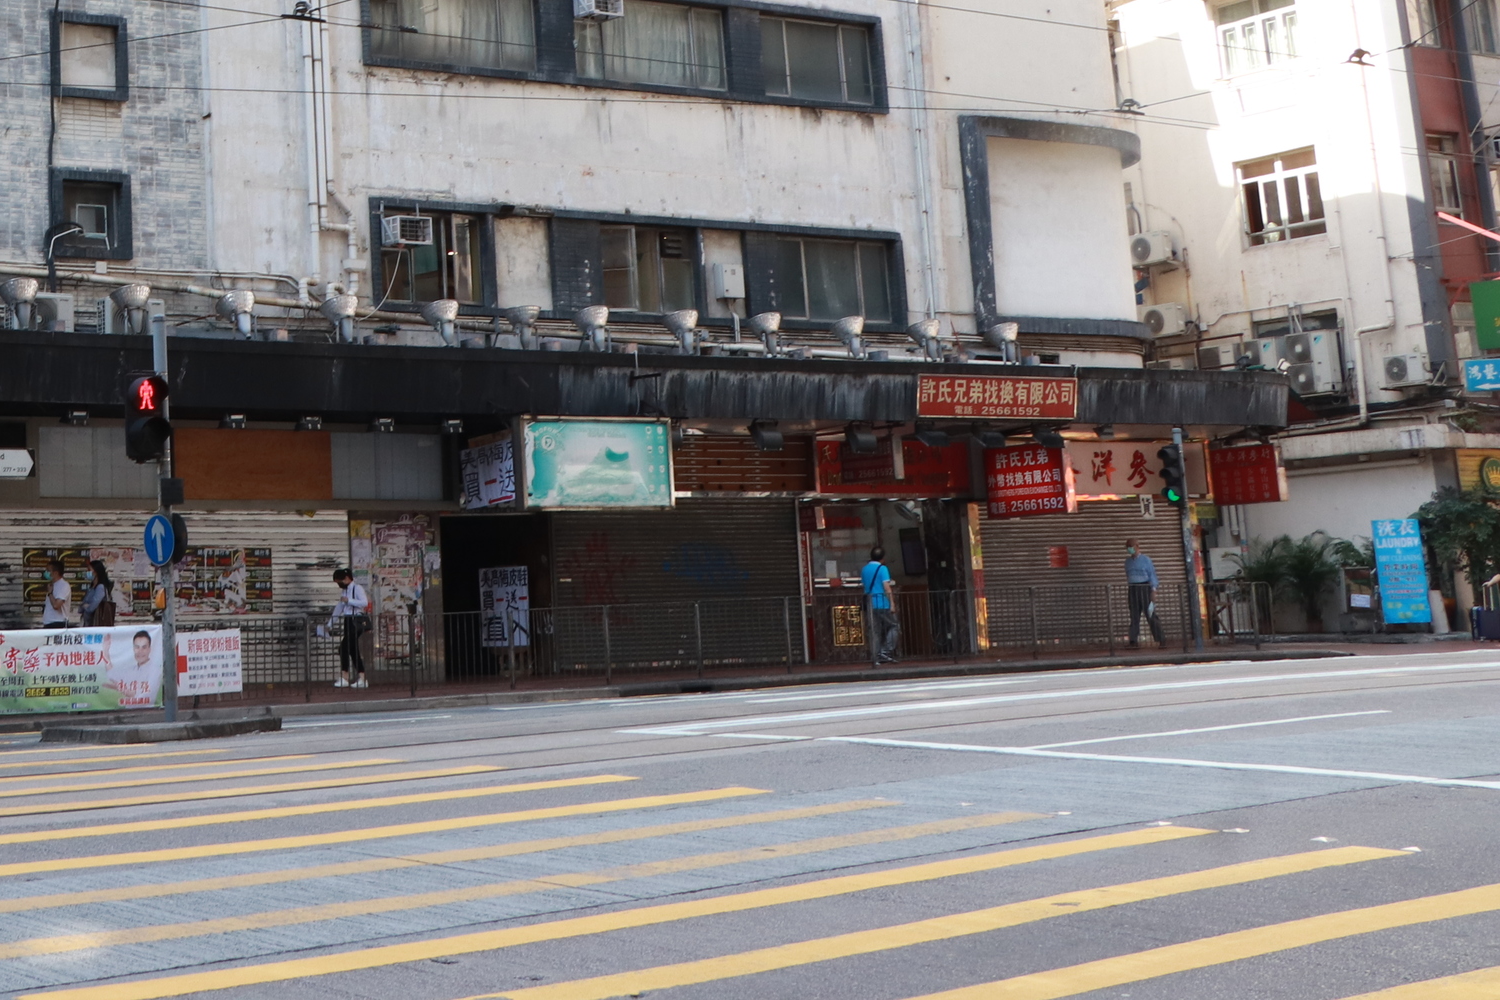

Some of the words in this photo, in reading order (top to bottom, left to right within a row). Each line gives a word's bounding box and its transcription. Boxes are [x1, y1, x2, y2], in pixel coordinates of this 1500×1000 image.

[921, 379, 1074, 405] 許氏兄弟找換有限公司
[981, 405, 1041, 416] 25661592
[995, 448, 1049, 470] 許氏兄弟
[987, 468, 1062, 489] 外幣找換有限公司
[1072, 449, 1155, 489] 洋參
[1010, 496, 1064, 513] 25661592
[1377, 520, 1416, 537] 洗衣
[1375, 537, 1420, 549] LAUNDRY
